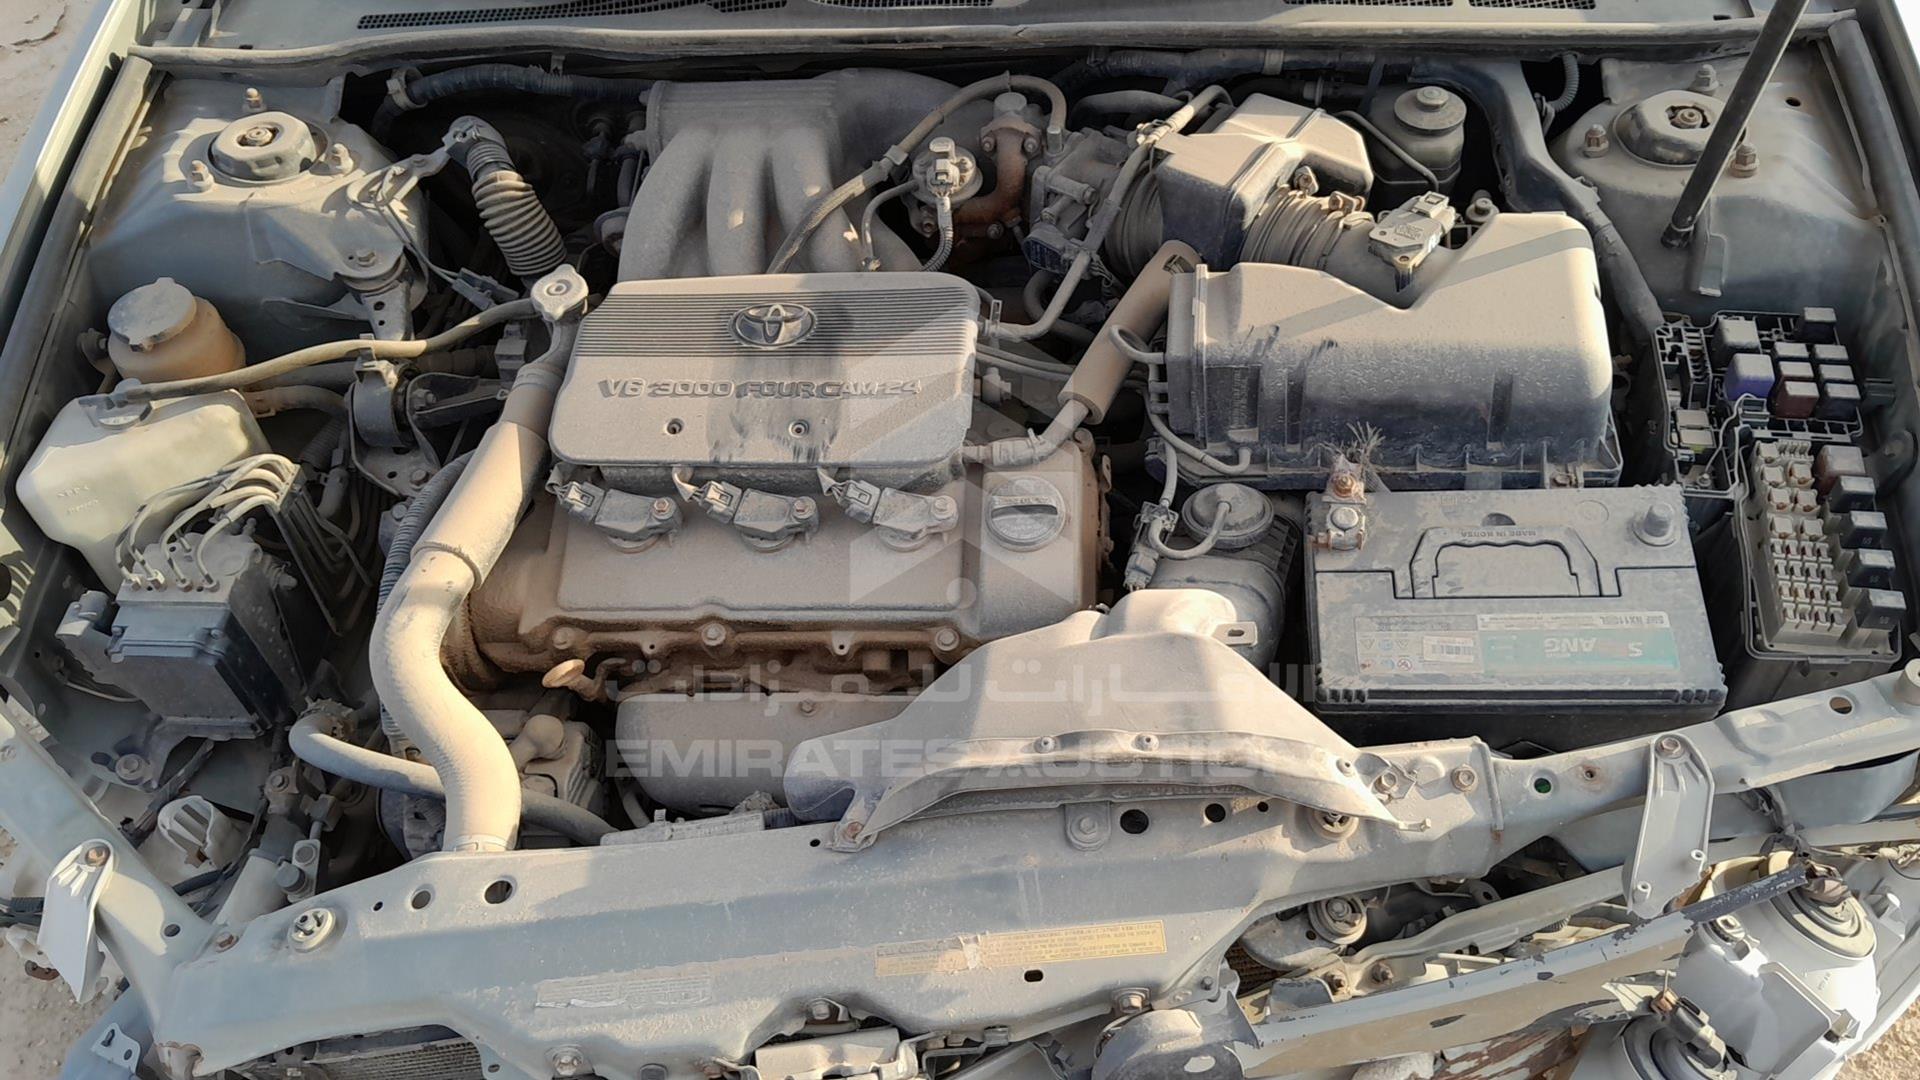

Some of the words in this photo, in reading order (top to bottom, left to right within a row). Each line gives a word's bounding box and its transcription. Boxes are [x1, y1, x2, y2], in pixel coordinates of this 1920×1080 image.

[602, 378, 647, 398] V6
[652, 380, 735, 398] 3000
[744, 381, 816, 399] FOUR
[818, 380, 879, 398] CAM
[883, 379, 921, 396] 24
